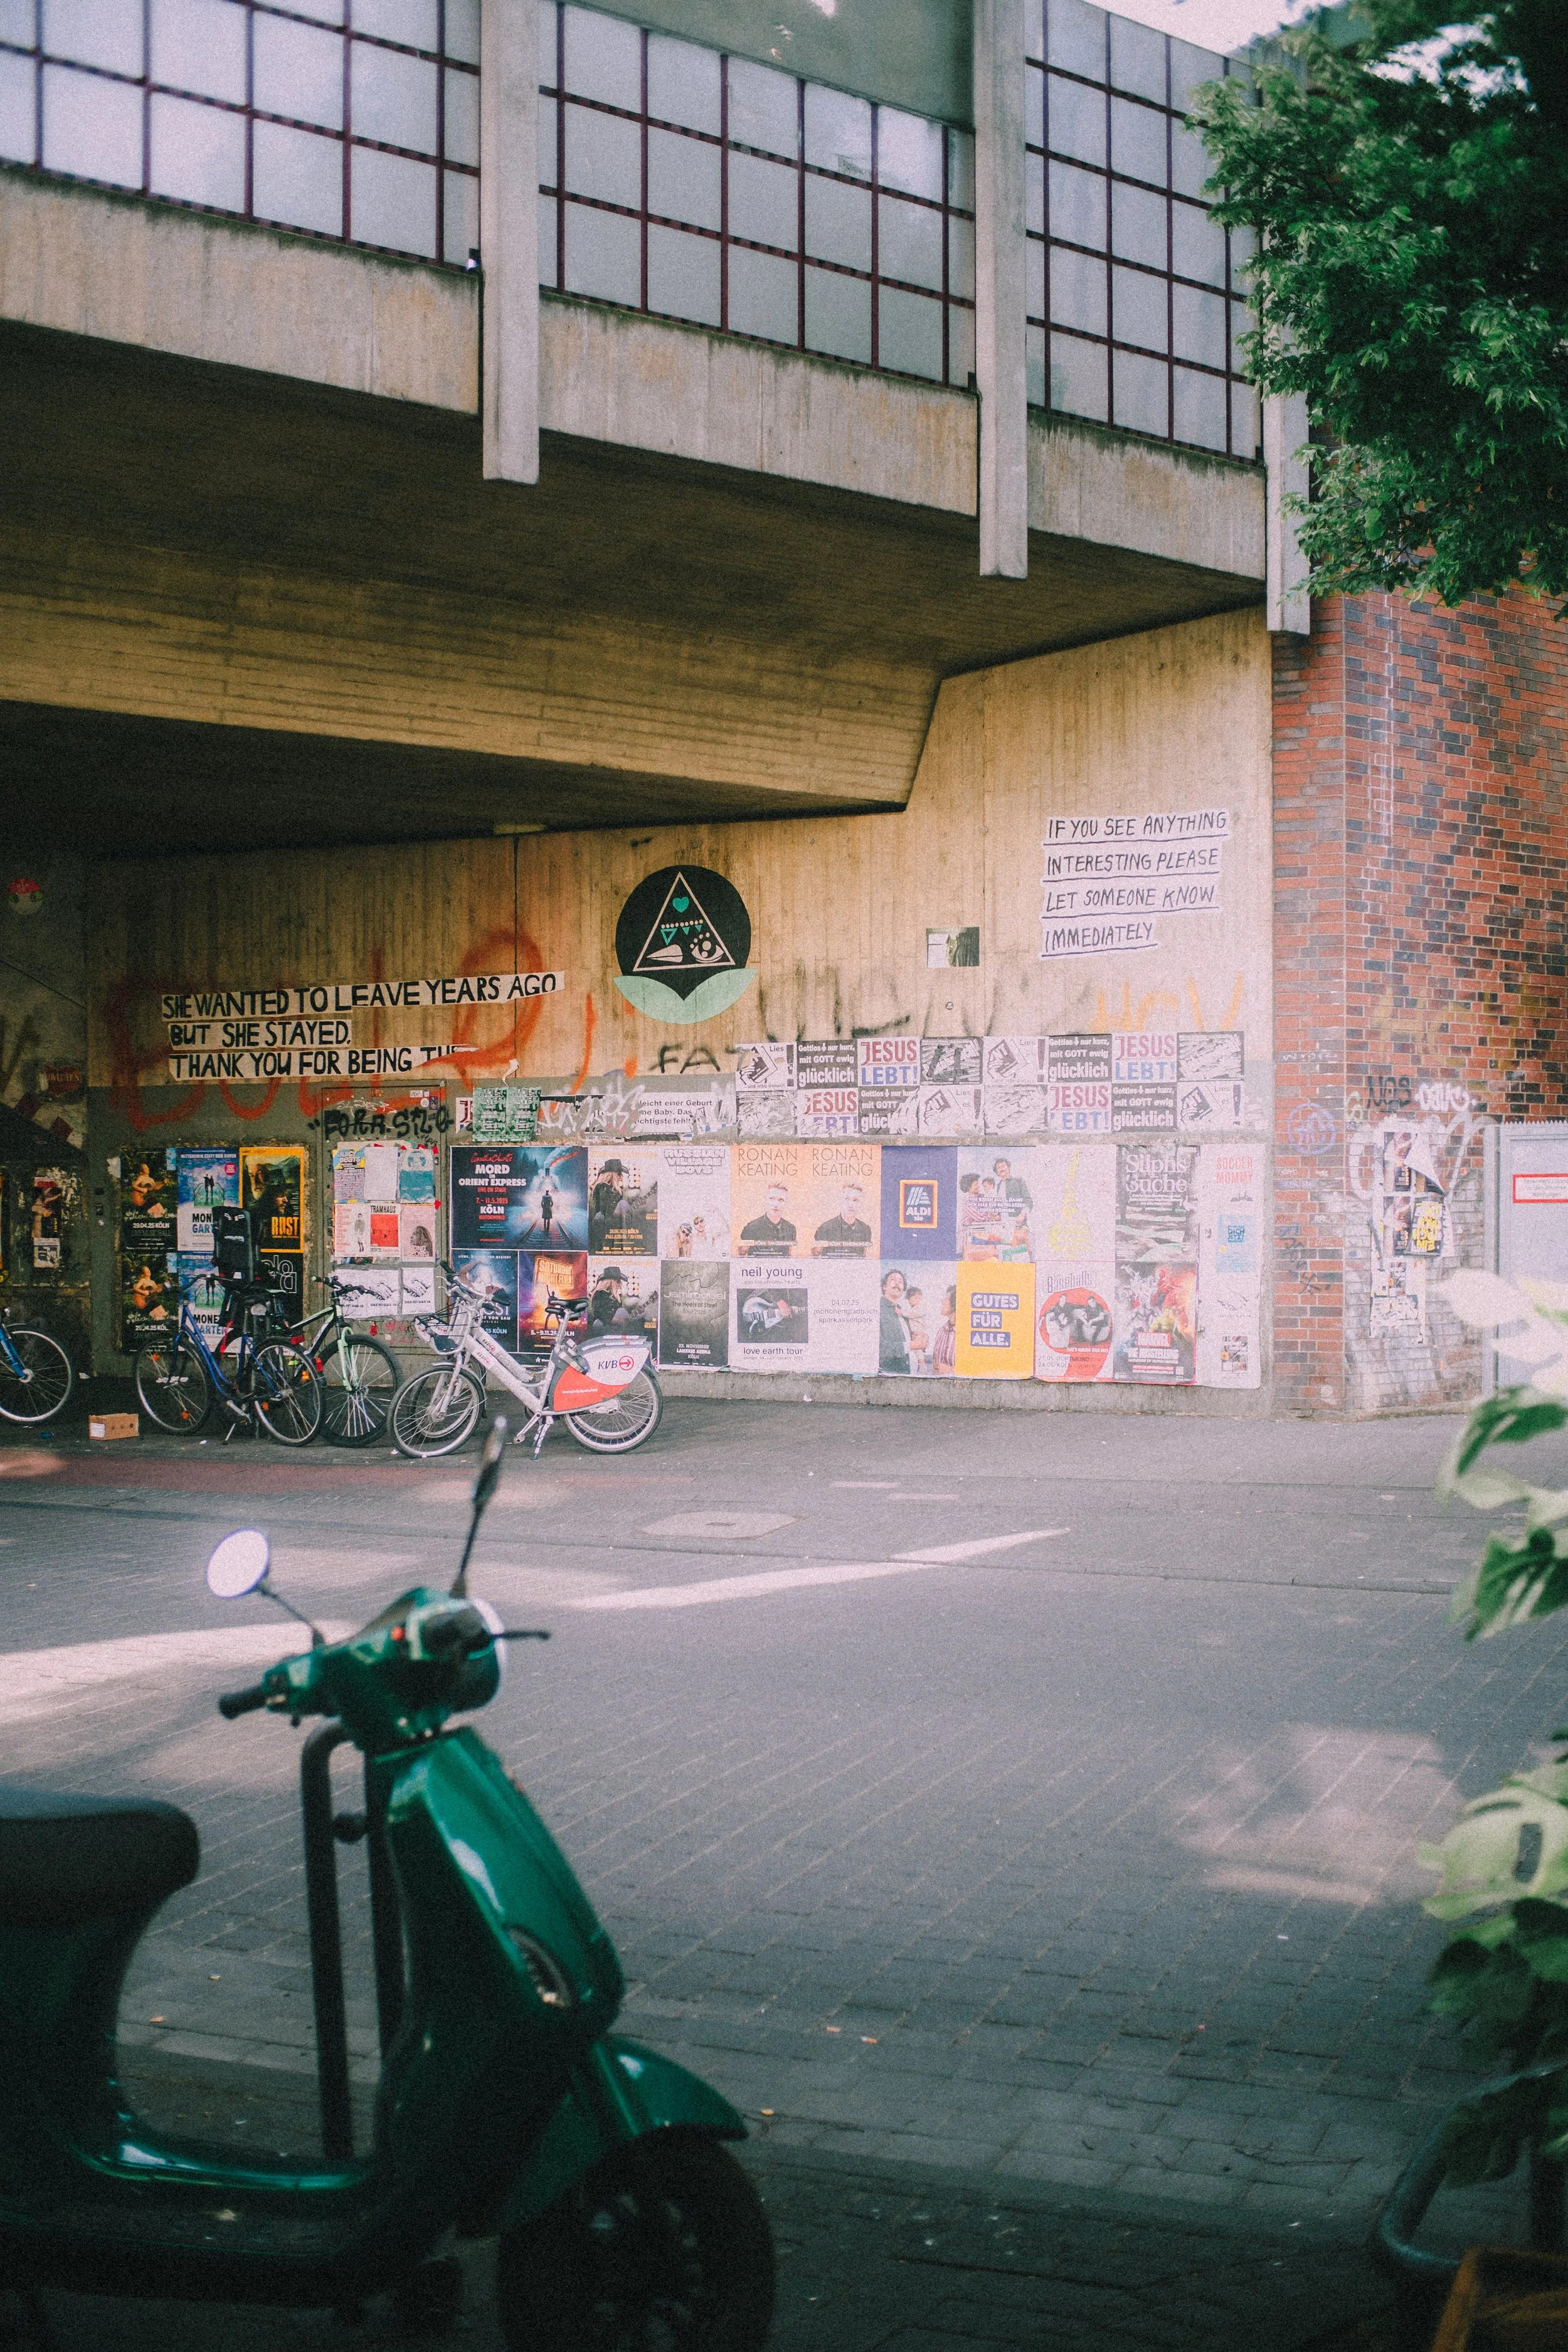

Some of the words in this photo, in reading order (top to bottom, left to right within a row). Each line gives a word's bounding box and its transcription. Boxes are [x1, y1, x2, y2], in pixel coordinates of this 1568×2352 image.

[1048, 818, 1065, 839] IF
[1071, 818, 1098, 839] YOU
[1103, 818, 1136, 836] SEE
[1143, 812, 1226, 835] ANYTHING
[1047, 853, 1152, 876] INTERESTING
[1157, 848, 1219, 872] PLEASE
[1046, 891, 1079, 912] LET
[1083, 888, 1157, 906] SOMEONE
[1162, 885, 1216, 908] KNOW
[1045, 922, 1153, 952] IMMEDIATELY
[162, 994, 192, 1019] SHE
[194, 989, 290, 1017] WANTED
[293, 987, 328, 1013] TO
[335, 980, 420, 1012] LEAVE
[425, 977, 501, 1004] YEARS
[506, 973, 556, 1000] AGO
[170, 1024, 211, 1046] BUT
[221, 1022, 260, 1048] SHE
[264, 1020, 352, 1047] STAYED.
[798, 1044, 821, 1052] Gottlos
[1049, 1038, 1073, 1046] Gottlos
[1115, 1035, 1175, 1061] JESUS
[835, 1054, 854, 1064] ewig
[861, 1040, 917, 1066] JESUS
[1064, 1049, 1088, 1057] GOTT
[1089, 1049, 1108, 1059] ewig
[168, 1053, 245, 1079] THANK
[250, 1052, 292, 1077] YOU
[299, 1050, 342, 1076] FOR
[347, 1047, 413, 1074] BEING
[798, 1067, 854, 1087] glücklich
[861, 1066, 918, 1085] LEBT!
[1049, 1061, 1109, 1082] glücklich
[1115, 1061, 1175, 1081] LEBT!
[876, 1101, 898, 1109] GOTT
[1049, 1086, 1109, 1111] JESUS
[1129, 1098, 1152, 1106] GOTT
[1153, 1098, 1173, 1108] ewig
[1113, 1110, 1174, 1131] glücklich
[664, 1149, 725, 1158] RUSSIAN
[738, 1148, 798, 1160] RONAN
[812, 1148, 873, 1161] RONAN
[665, 1157, 722, 1166] VILLAGE
[1216, 1157, 1253, 1170] SOCCER
[475, 1164, 510, 1174] MORD
[675, 1165, 713, 1174] BOYS
[738, 1163, 798, 1176] KEATING
[812, 1163, 873, 1177] KEATING
[458, 1178, 489, 1186] ORIENT
[490, 1178, 526, 1187] EXPRESS
[1216, 1171, 1254, 1184] MOMMY
[370, 1205, 396, 1214] TRAMHAUS
[480, 1204, 504, 1214] KÖLN
[906, 1207, 931, 1216] ALDI
[192, 1213, 213, 1223] MON
[271, 1216, 299, 1236] RUST
[741, 1266, 762, 1277] neil
[766, 1269, 803, 1279] young
[972, 1295, 1018, 1308] GUTES
[973, 1311, 1001, 1327] FÜR
[492, 1327, 507, 1335] KÖLN
[972, 1333, 1009, 1346] ALLE.
[598, 1360, 618, 1370] KVB
